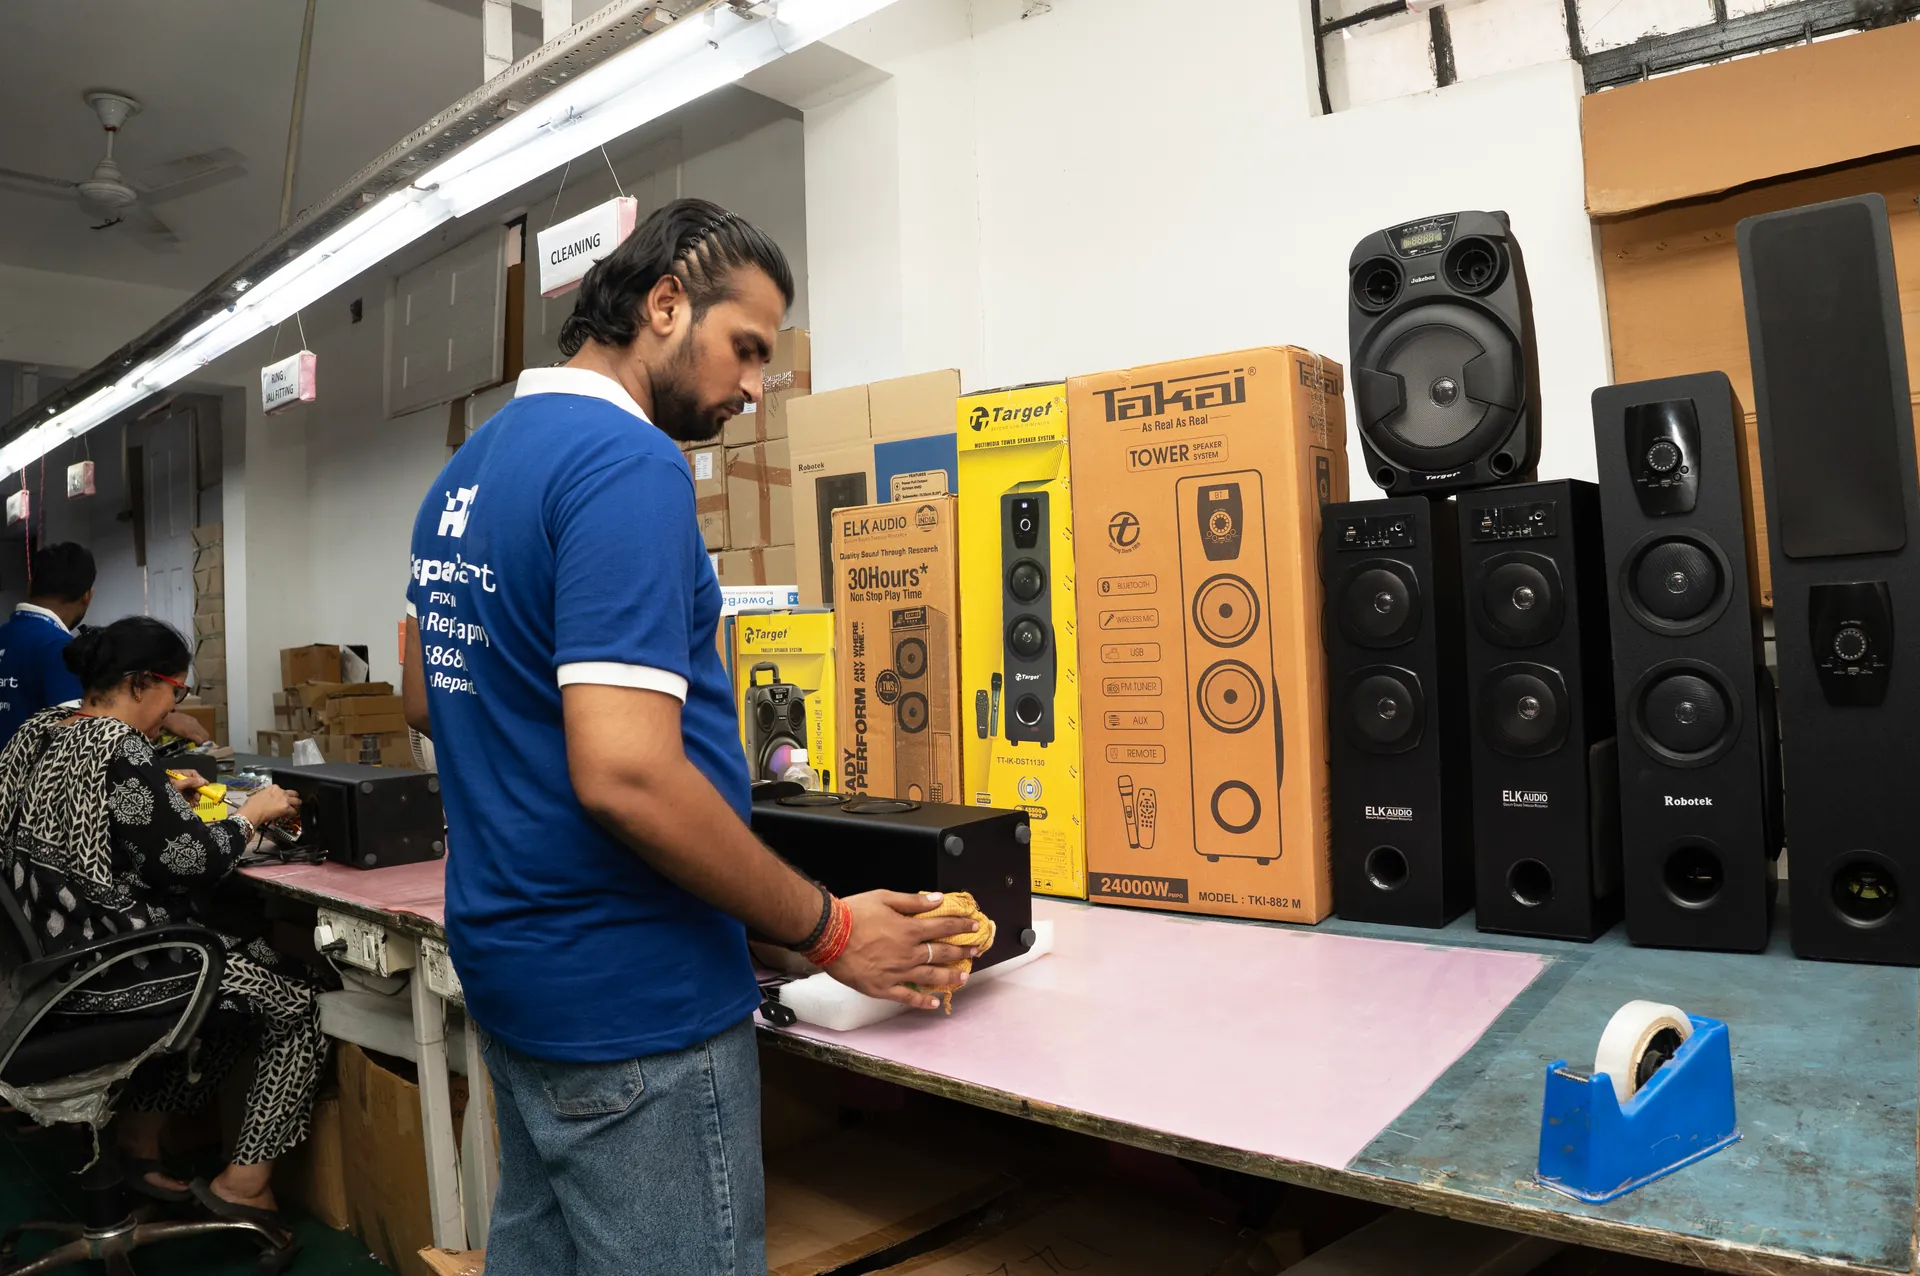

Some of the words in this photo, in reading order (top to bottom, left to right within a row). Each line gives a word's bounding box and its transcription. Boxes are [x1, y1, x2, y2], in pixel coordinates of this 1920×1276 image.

[551, 233, 601, 265] CLEANING
[1411, 275, 1435, 284] Jukebox
[275, 384, 294, 400] FITTING
[1092, 368, 1246, 422] Takai
[993, 401, 1052, 423] Target
[1142, 422, 1152, 432] As
[1155, 419, 1173, 431] Real
[1176, 417, 1186, 428] As
[1189, 414, 1208, 427] Real
[1193, 441, 1222, 451] SPEAKER
[1130, 444, 1189, 467] TOWER
[1193, 451, 1219, 461] SYSTEM
[798, 461, 825, 472] Robotek
[1426, 472, 1457, 480] Target
[844, 519, 870, 537] ELK
[872, 516, 907, 532] AUDIO
[840, 552, 860, 560] Quality
[861, 550, 879, 558] Sound
[881, 548, 906, 556] Through
[908, 545, 938, 554] Research
[1117, 581, 1150, 589] BLUETOOTH
[850, 592, 864, 602] Non
[866, 591, 882, 602] Stop
[885, 590, 901, 601] Play
[903, 589, 922, 599] Time
[1116, 616, 1142, 624] WIRELESS
[756, 629, 788, 641] Target
[1130, 648, 1144, 657] USB
[882, 680, 895, 691] TWS
[1121, 683, 1132, 691] FM
[1133, 682, 1157, 691] TUNER
[1132, 716, 1148, 725] AUX
[854, 688, 868, 788] PERFORM
[1127, 749, 1157, 758] REMOTE
[997, 757, 1045, 767] TT-IK-DST1130
[1502, 790, 1523, 802] ELK
[1523, 793, 1548, 802] AUDIO
[1664, 795, 1713, 806] Robotek
[1365, 806, 1386, 816] ELK
[1386, 808, 1413, 816] AUDIO
[1101, 877, 1169, 897] 24000W
[1198, 891, 1238, 904] MODEL
[1248, 895, 1289, 908] TKI-882
[1292, 899, 1301, 909] M
